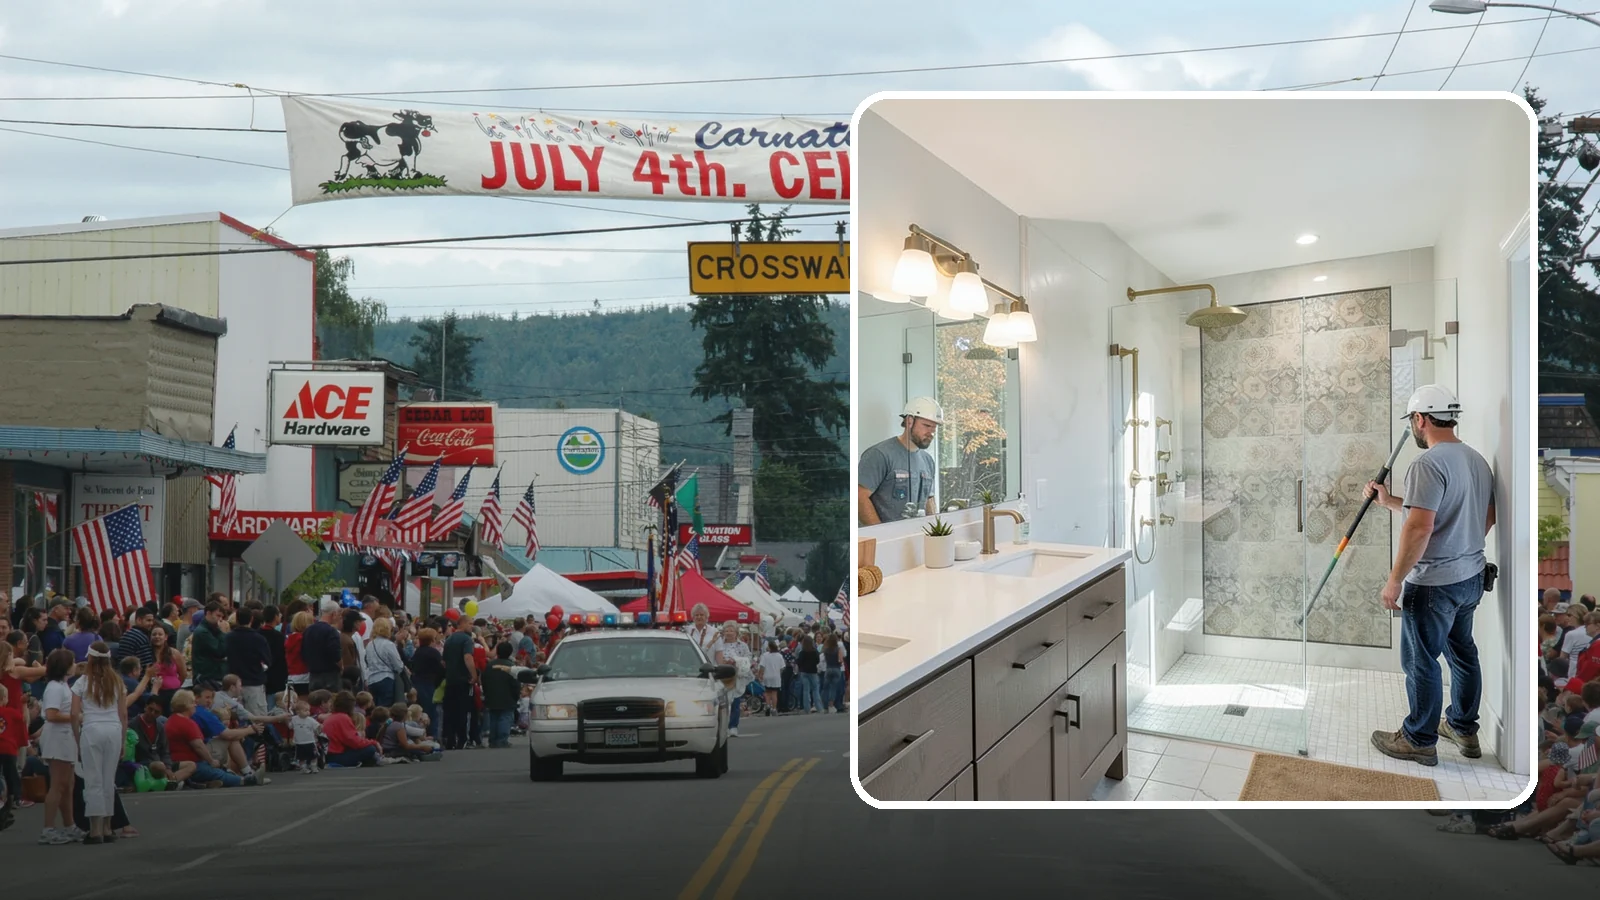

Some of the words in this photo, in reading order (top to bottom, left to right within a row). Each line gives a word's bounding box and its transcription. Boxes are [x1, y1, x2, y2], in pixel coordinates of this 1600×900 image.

[481, 141, 604, 192] JULY
[632, 150, 746, 197] 4th.
[697, 254, 850, 280] CROSSWA
[283, 380, 373, 420] ACE
[283, 421, 371, 436] Hardware
[96, 485, 124, 495] Vincent
[126, 486, 135, 495] de
[138, 486, 155, 495] Paul
[688, 526, 741, 535] CRNATION
[699, 535, 730, 543] GLASS
